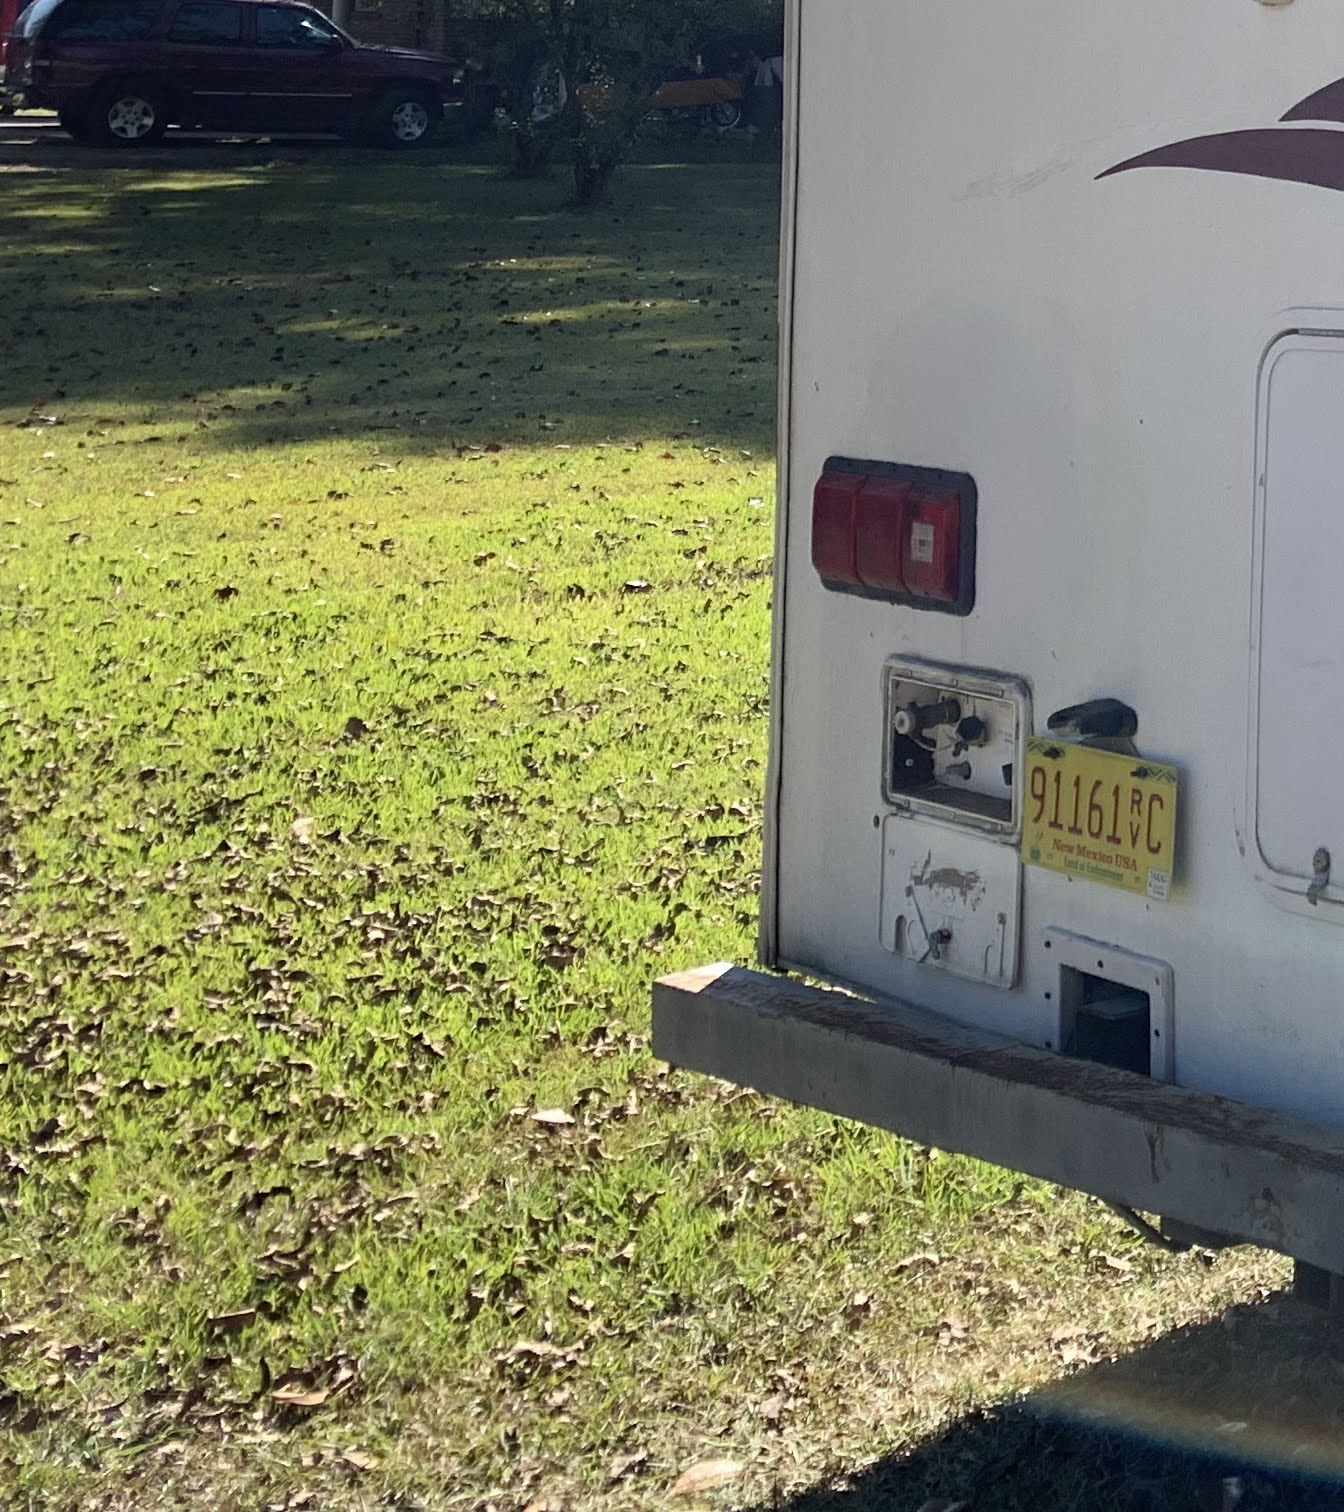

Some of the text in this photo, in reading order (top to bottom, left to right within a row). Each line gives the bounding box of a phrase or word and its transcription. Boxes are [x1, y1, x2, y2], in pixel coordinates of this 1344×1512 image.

[1052, 838, 1075, 856] New
[1076, 842, 1114, 866] Mexico
[1115, 853, 1137, 872] USA
